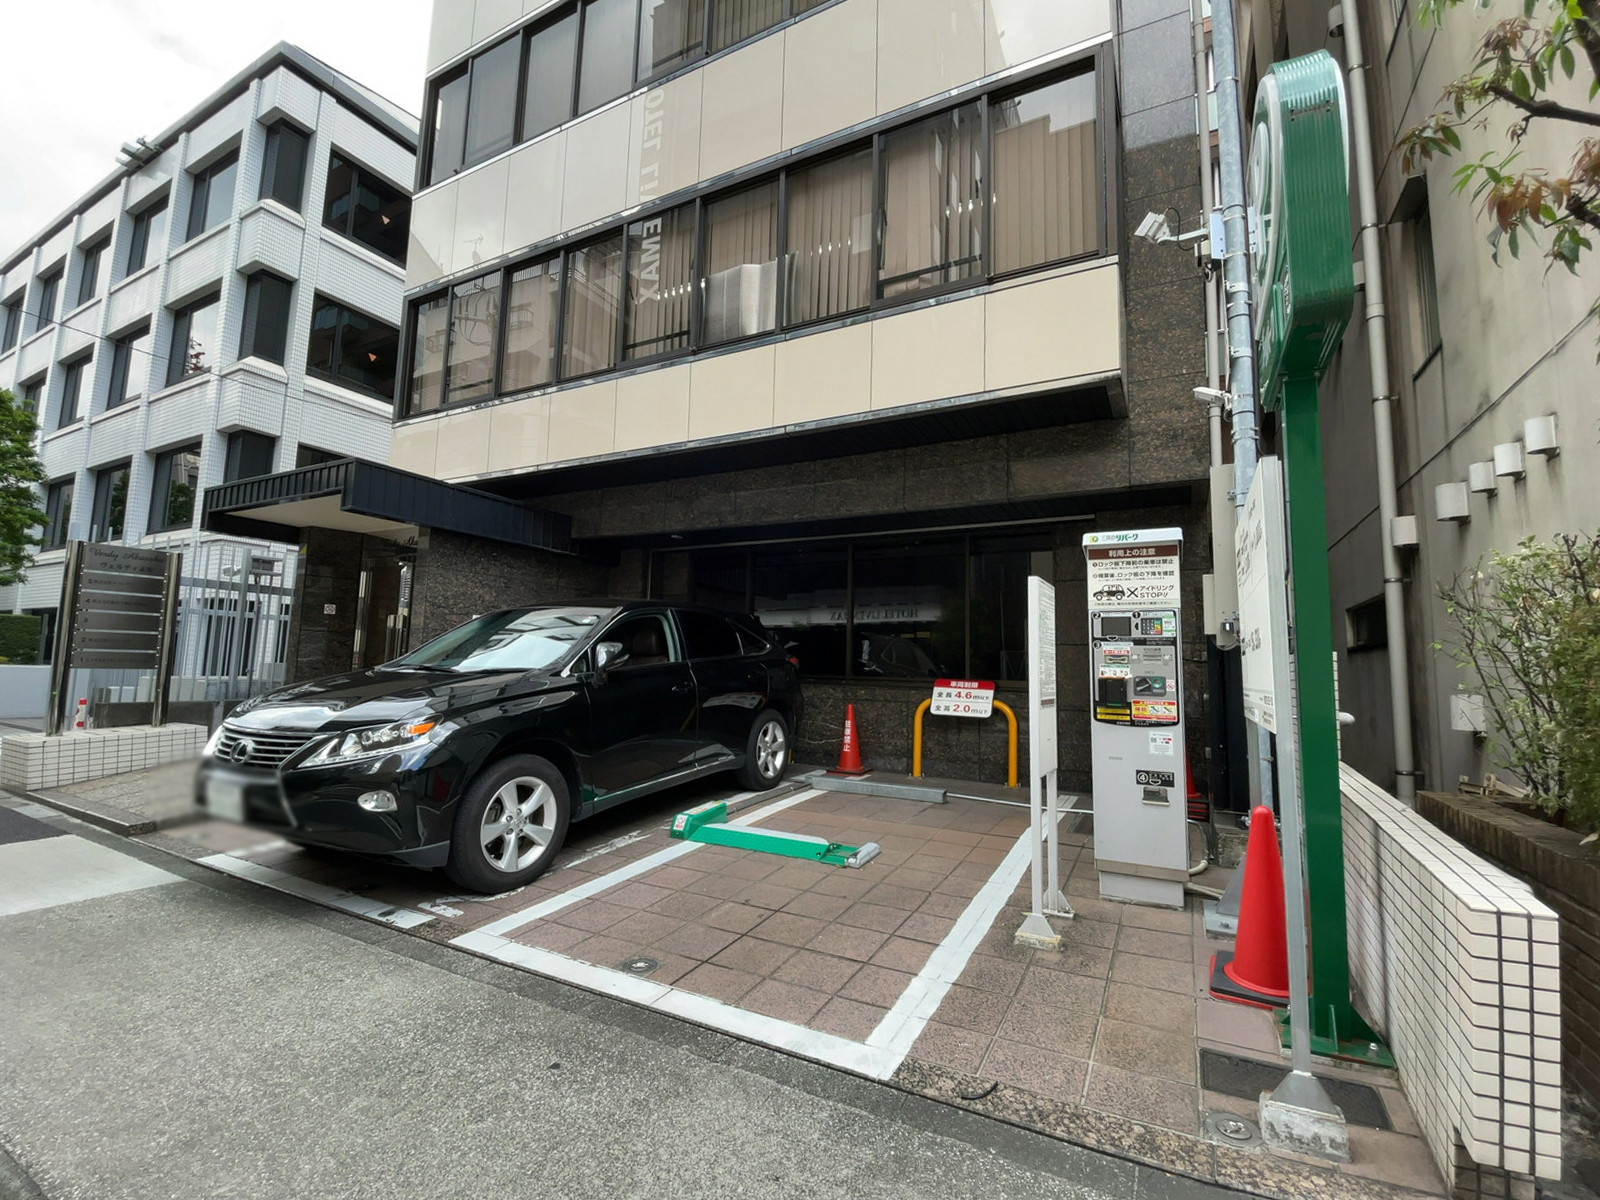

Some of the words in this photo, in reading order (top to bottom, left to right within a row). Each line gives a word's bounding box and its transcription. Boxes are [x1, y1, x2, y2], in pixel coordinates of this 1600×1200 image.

[1108, 548, 1156, 558] 利用上の注意
